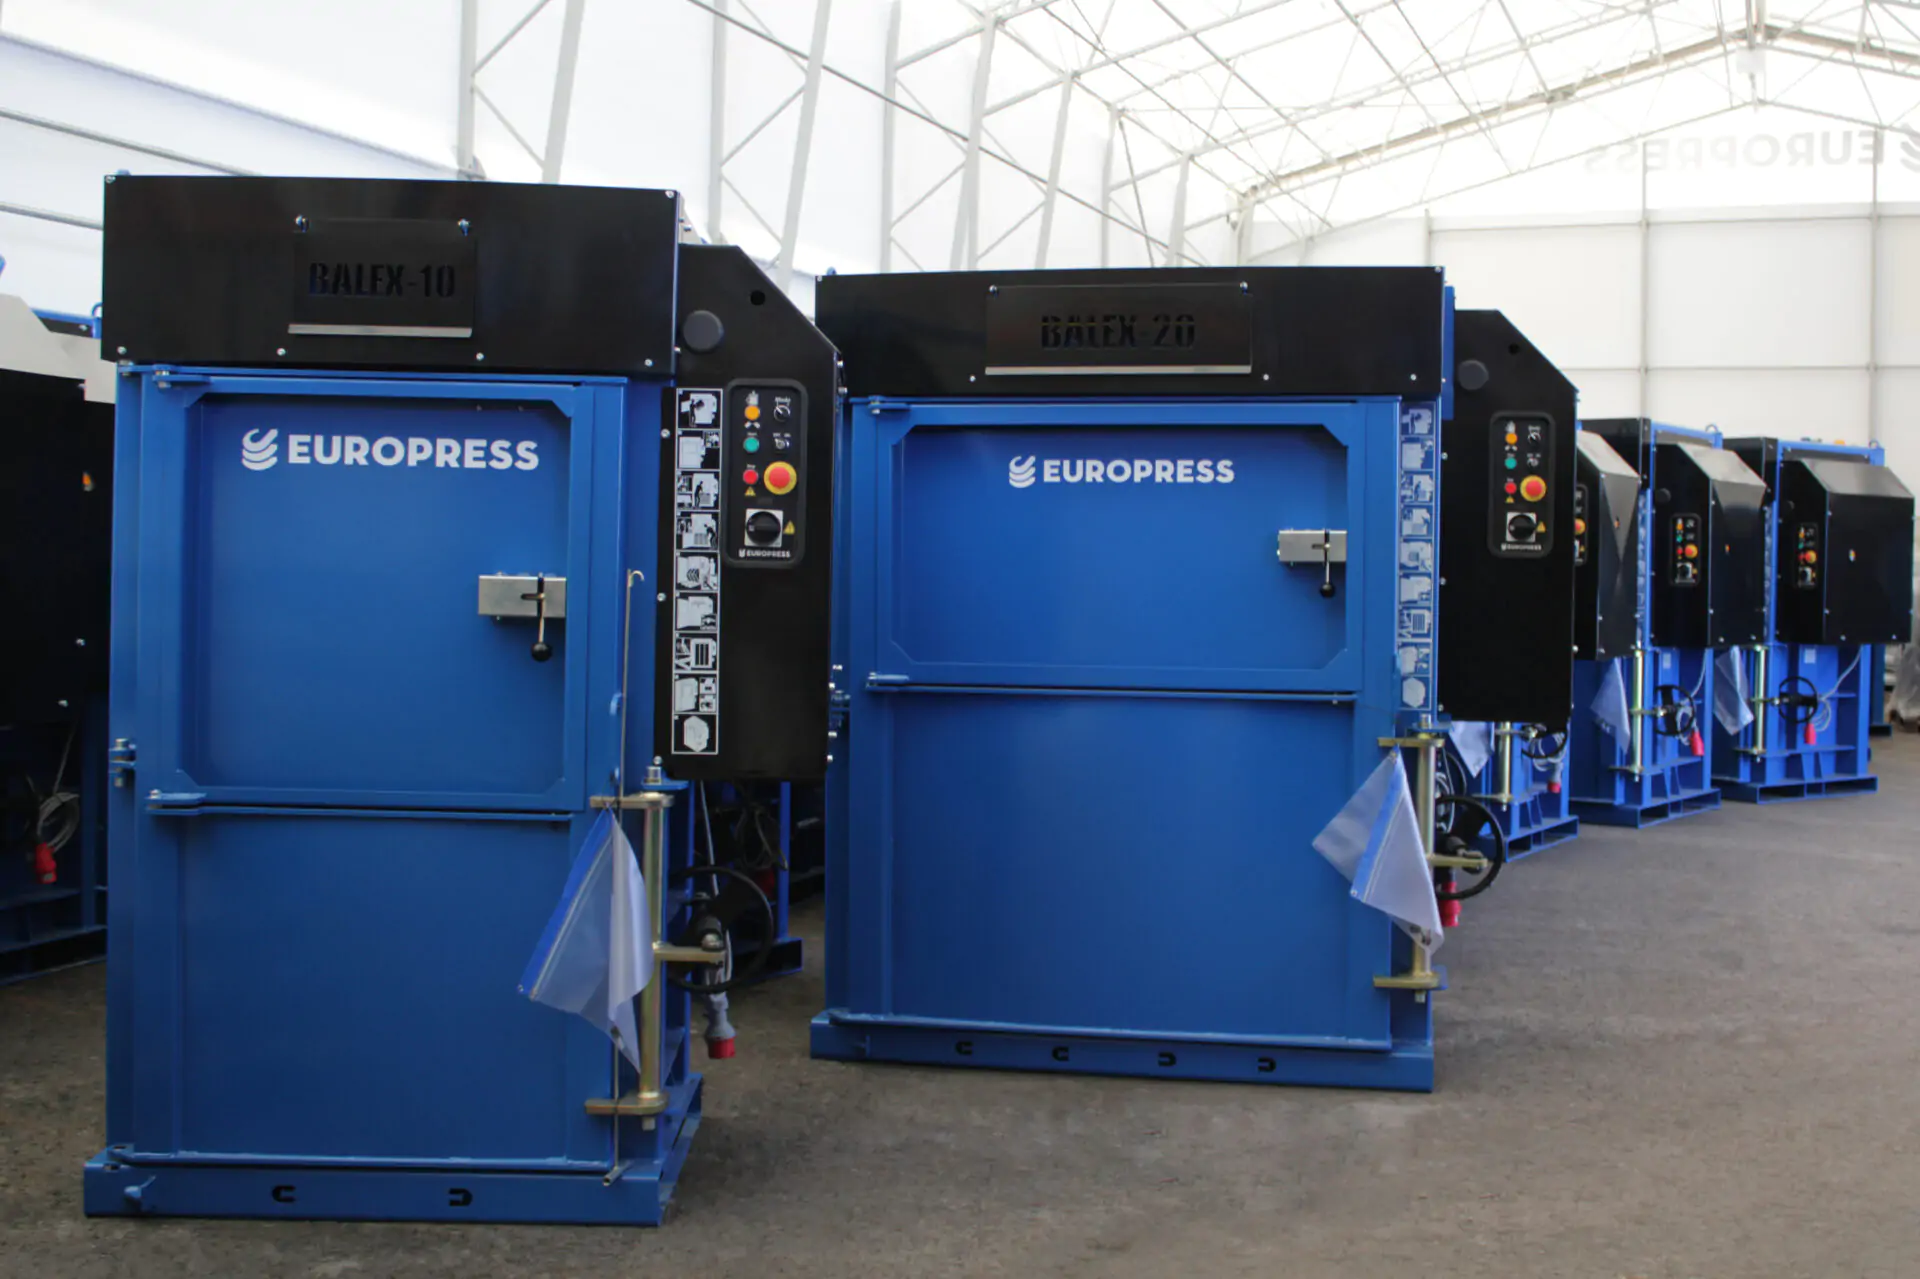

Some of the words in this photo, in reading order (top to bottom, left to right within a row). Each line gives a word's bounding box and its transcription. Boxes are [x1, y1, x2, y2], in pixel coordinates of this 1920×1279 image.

[309, 262, 455, 298] BALEX-10
[288, 434, 539, 471] EUROPRESS
[1043, 459, 1235, 484] EUROPRESS
